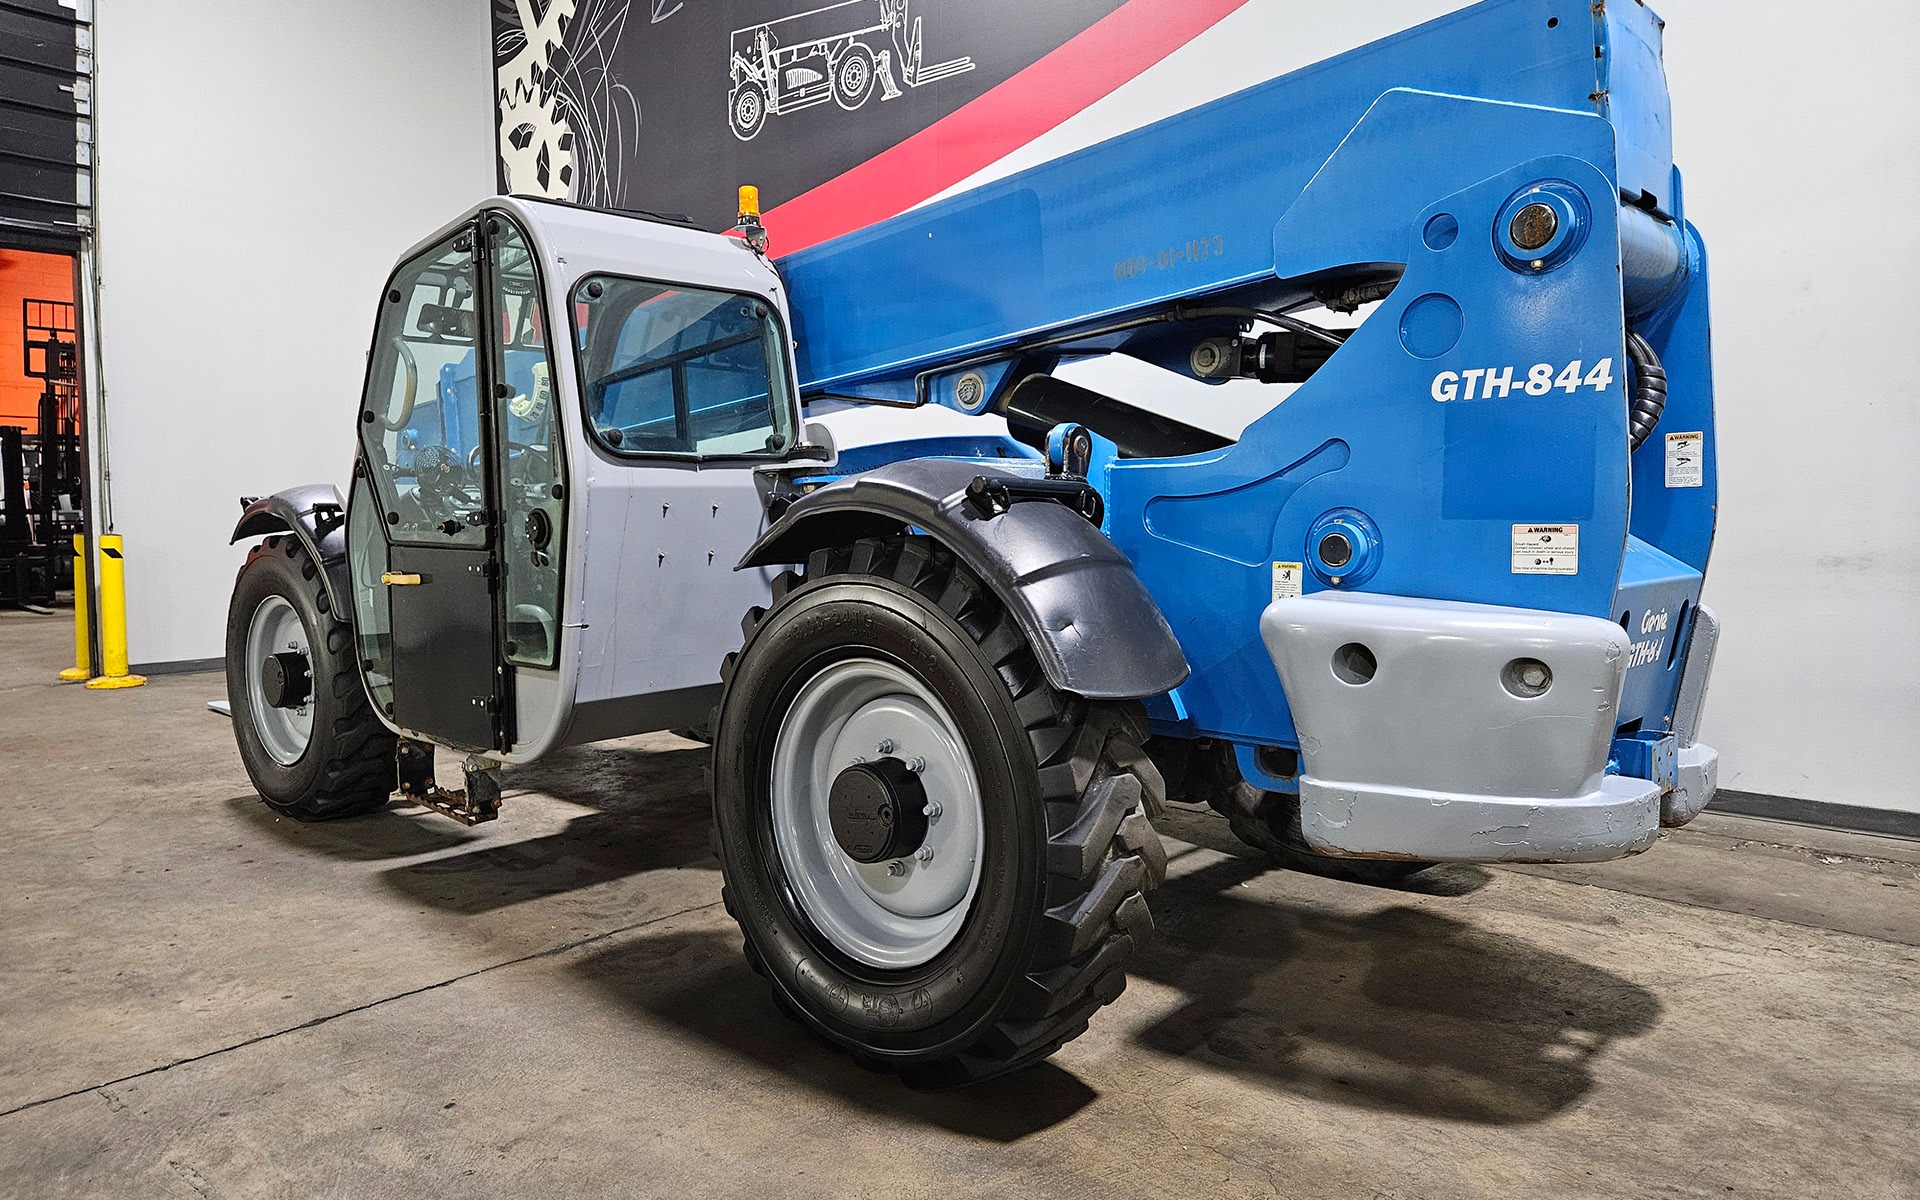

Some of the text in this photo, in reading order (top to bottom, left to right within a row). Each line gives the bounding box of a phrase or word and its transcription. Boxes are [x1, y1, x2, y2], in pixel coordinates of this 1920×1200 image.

[1431, 357, 1613, 403] GTH-844
[539, 391, 550, 400] 60
[1641, 608, 1668, 635] Genie
